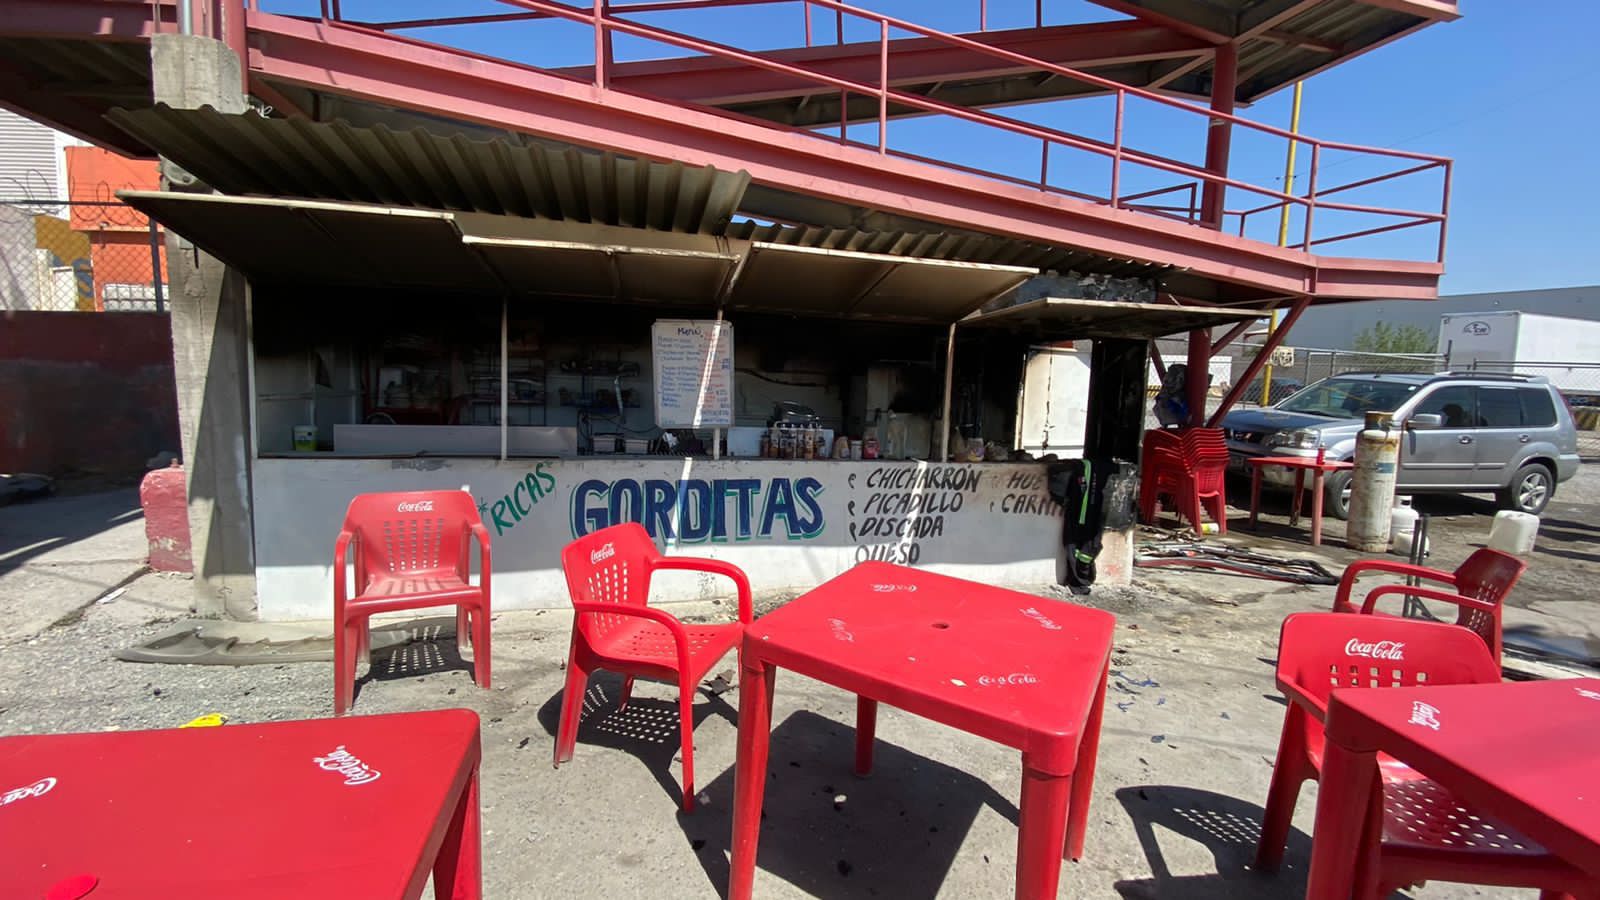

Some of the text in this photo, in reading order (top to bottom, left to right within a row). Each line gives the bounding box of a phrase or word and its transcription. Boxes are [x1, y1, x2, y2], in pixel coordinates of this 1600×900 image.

[1007, 471, 1043, 492] HUE
[491, 462, 557, 536] RICAS
[863, 491, 964, 516] PICADILLO
[569, 477, 826, 546] GORDITAS
[858, 515, 944, 538] DISCADA
[1344, 638, 1404, 660] Coca-Cola
